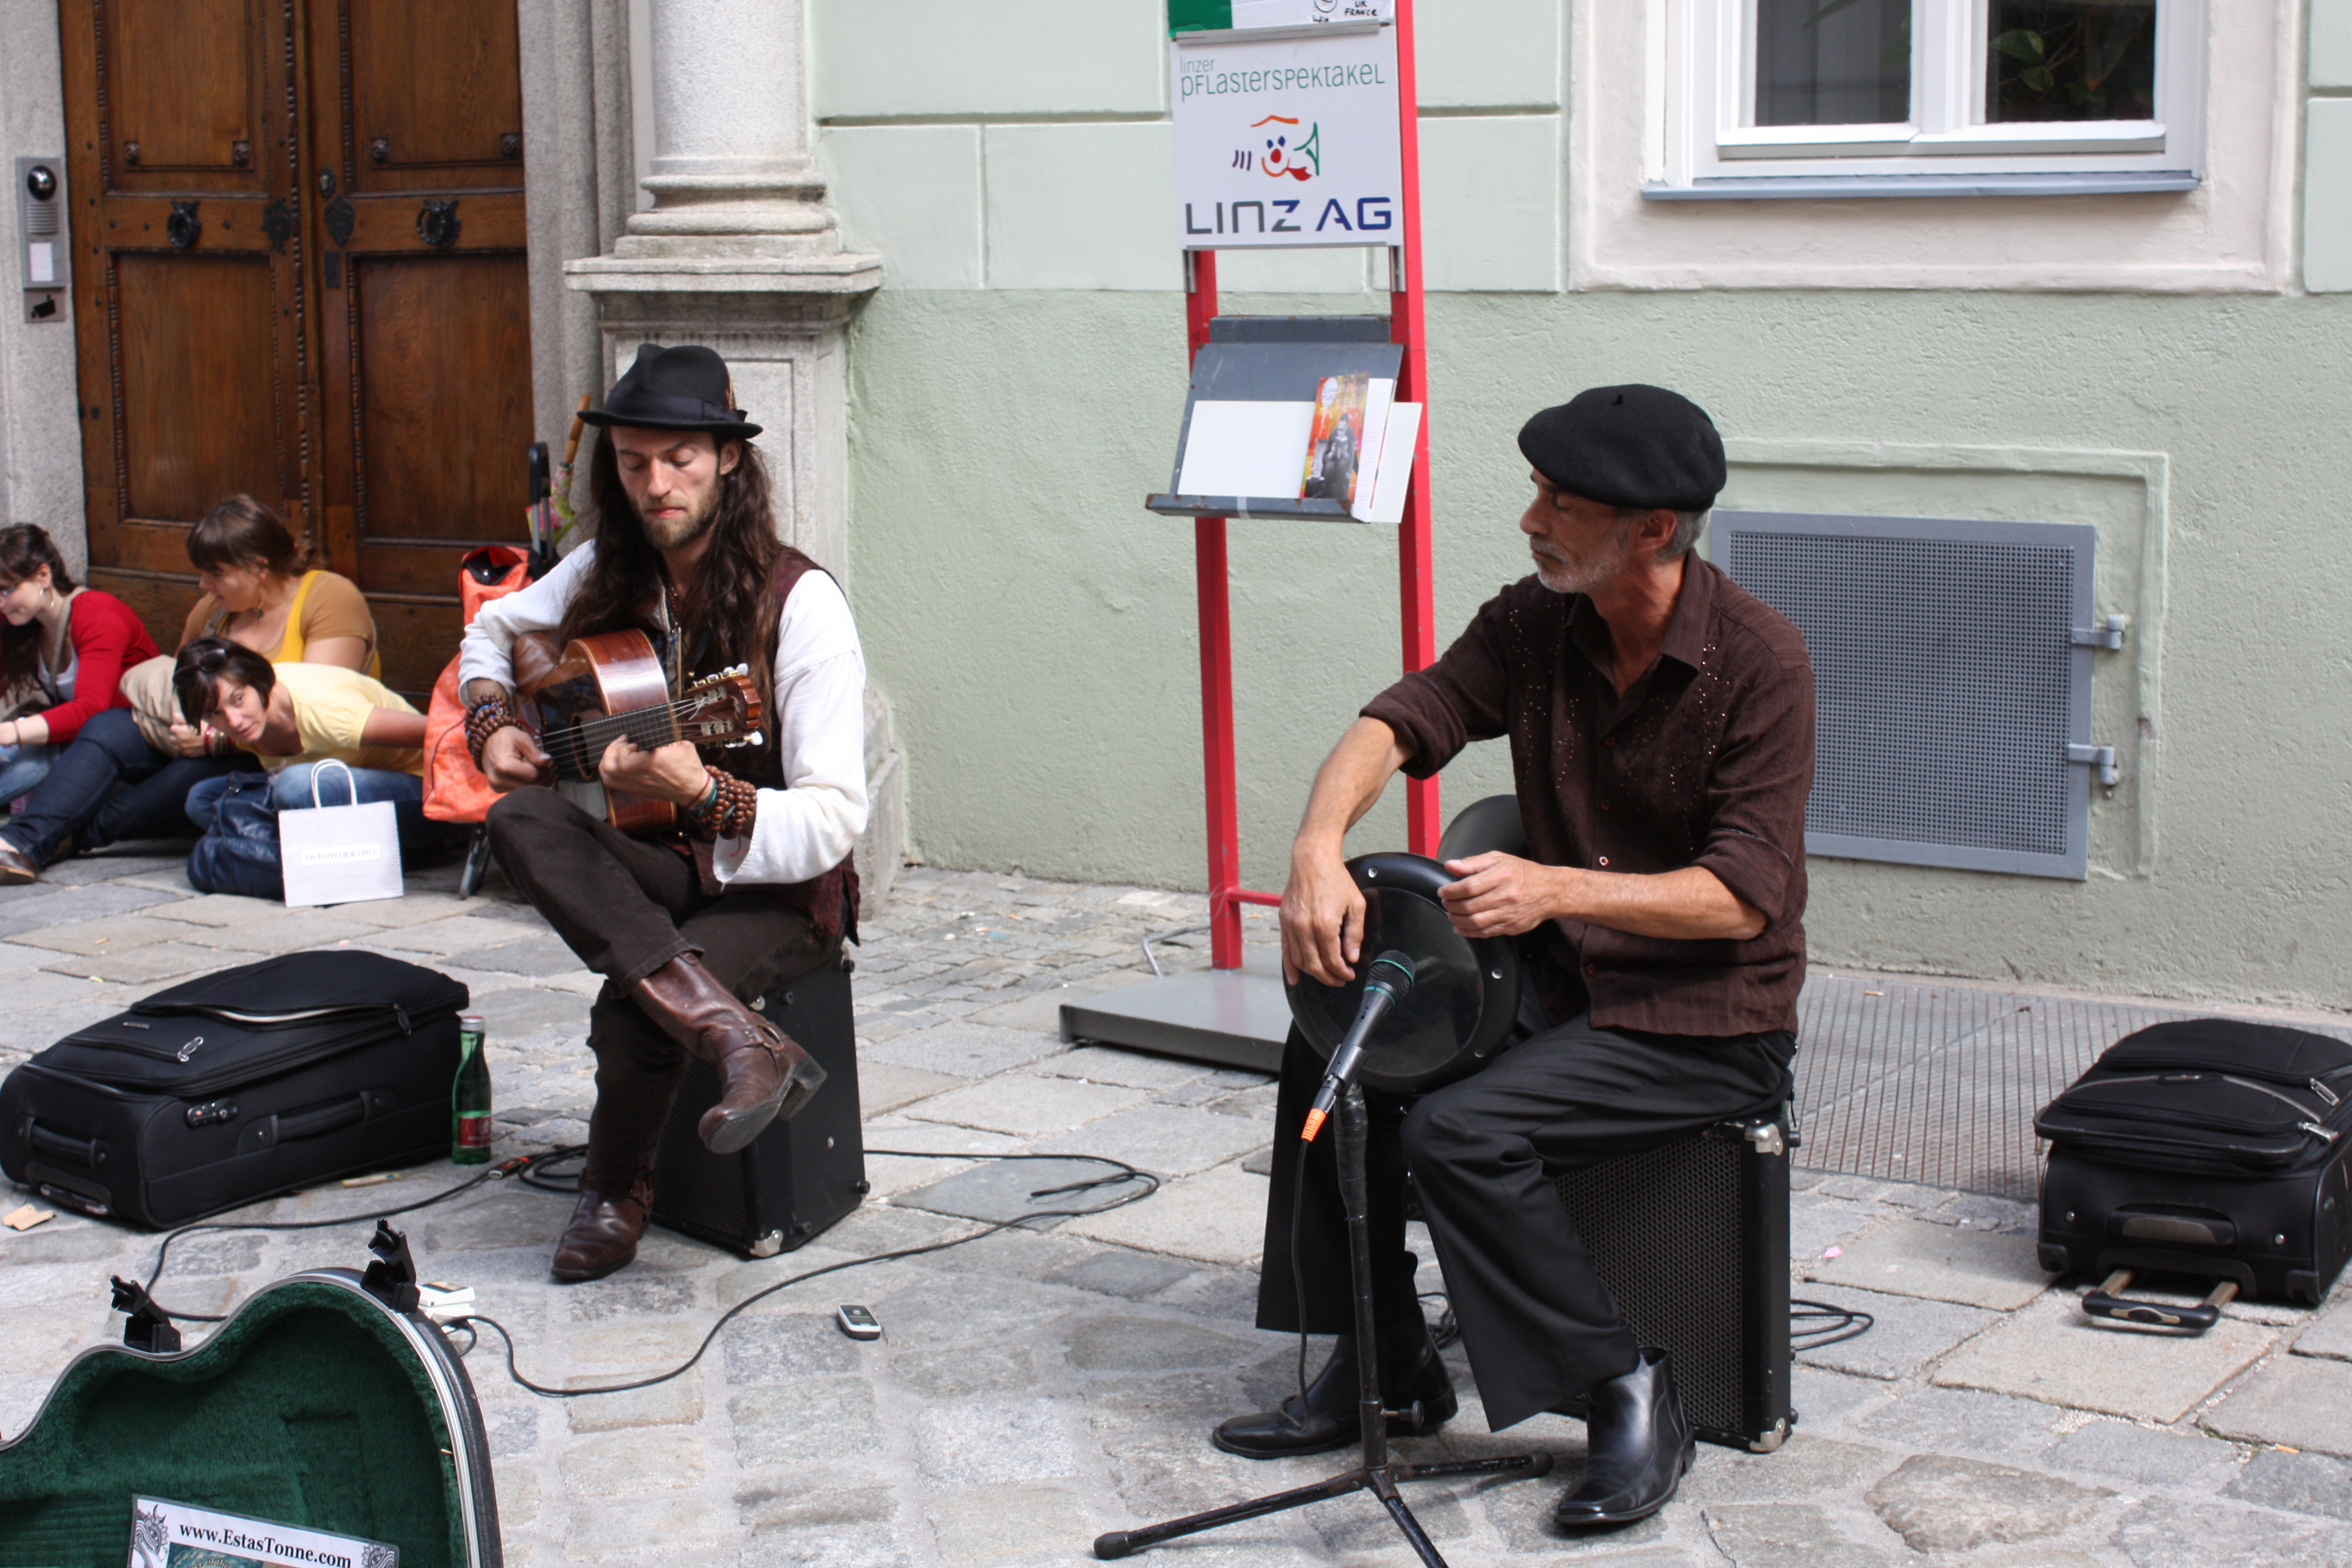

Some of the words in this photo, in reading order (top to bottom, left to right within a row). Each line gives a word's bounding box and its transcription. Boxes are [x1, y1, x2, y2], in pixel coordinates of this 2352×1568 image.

[1180, 57, 1216, 74] linzer
[1315, 197, 1392, 232] AG
[304, 849, 377, 862] intimissimi
[179, 1523, 352, 1568] www.EstasTonne.com
